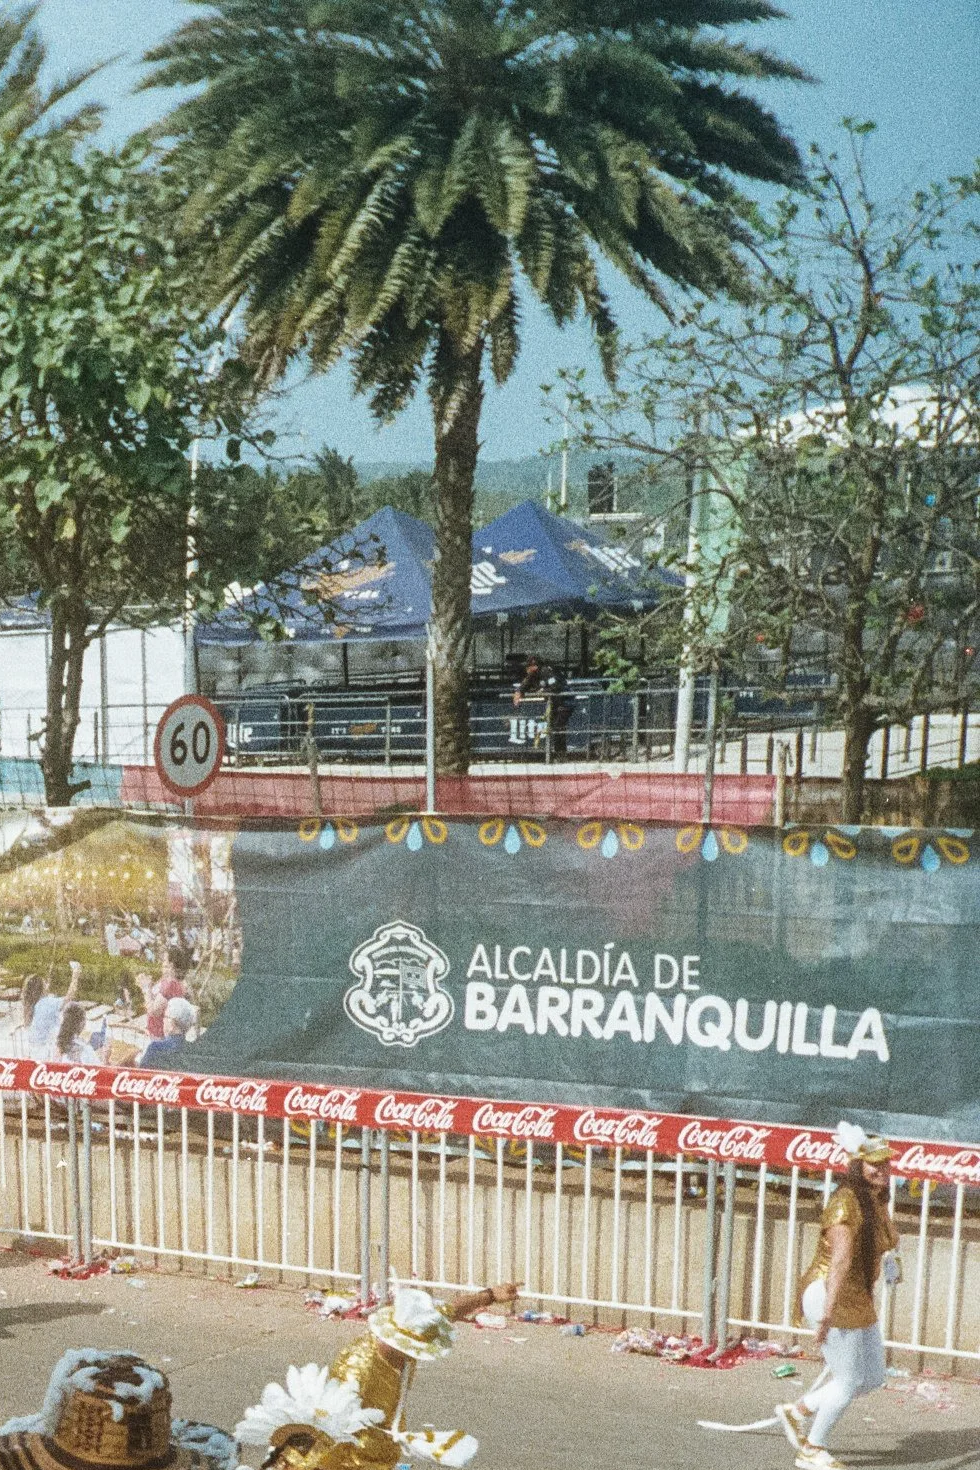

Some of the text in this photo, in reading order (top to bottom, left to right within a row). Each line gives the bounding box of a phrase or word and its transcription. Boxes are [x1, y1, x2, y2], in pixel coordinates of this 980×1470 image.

[170, 721, 210, 766] 60
[466, 942, 701, 991] ALCALDÍA DE
[464, 981, 891, 1063] BARRANQUILLA
[29, 1064, 100, 1096] Coca-Cola
[111, 1072, 184, 1103] Coca-Cola
[196, 1078, 270, 1112] Coca-Cola
[284, 1086, 361, 1122] Coca-Cola
[374, 1095, 459, 1130] Coca-Cola
[472, 1104, 559, 1139] Coca-Cola
[573, 1110, 662, 1148] Coca-Cola
[677, 1121, 772, 1160] Coca-Cola
